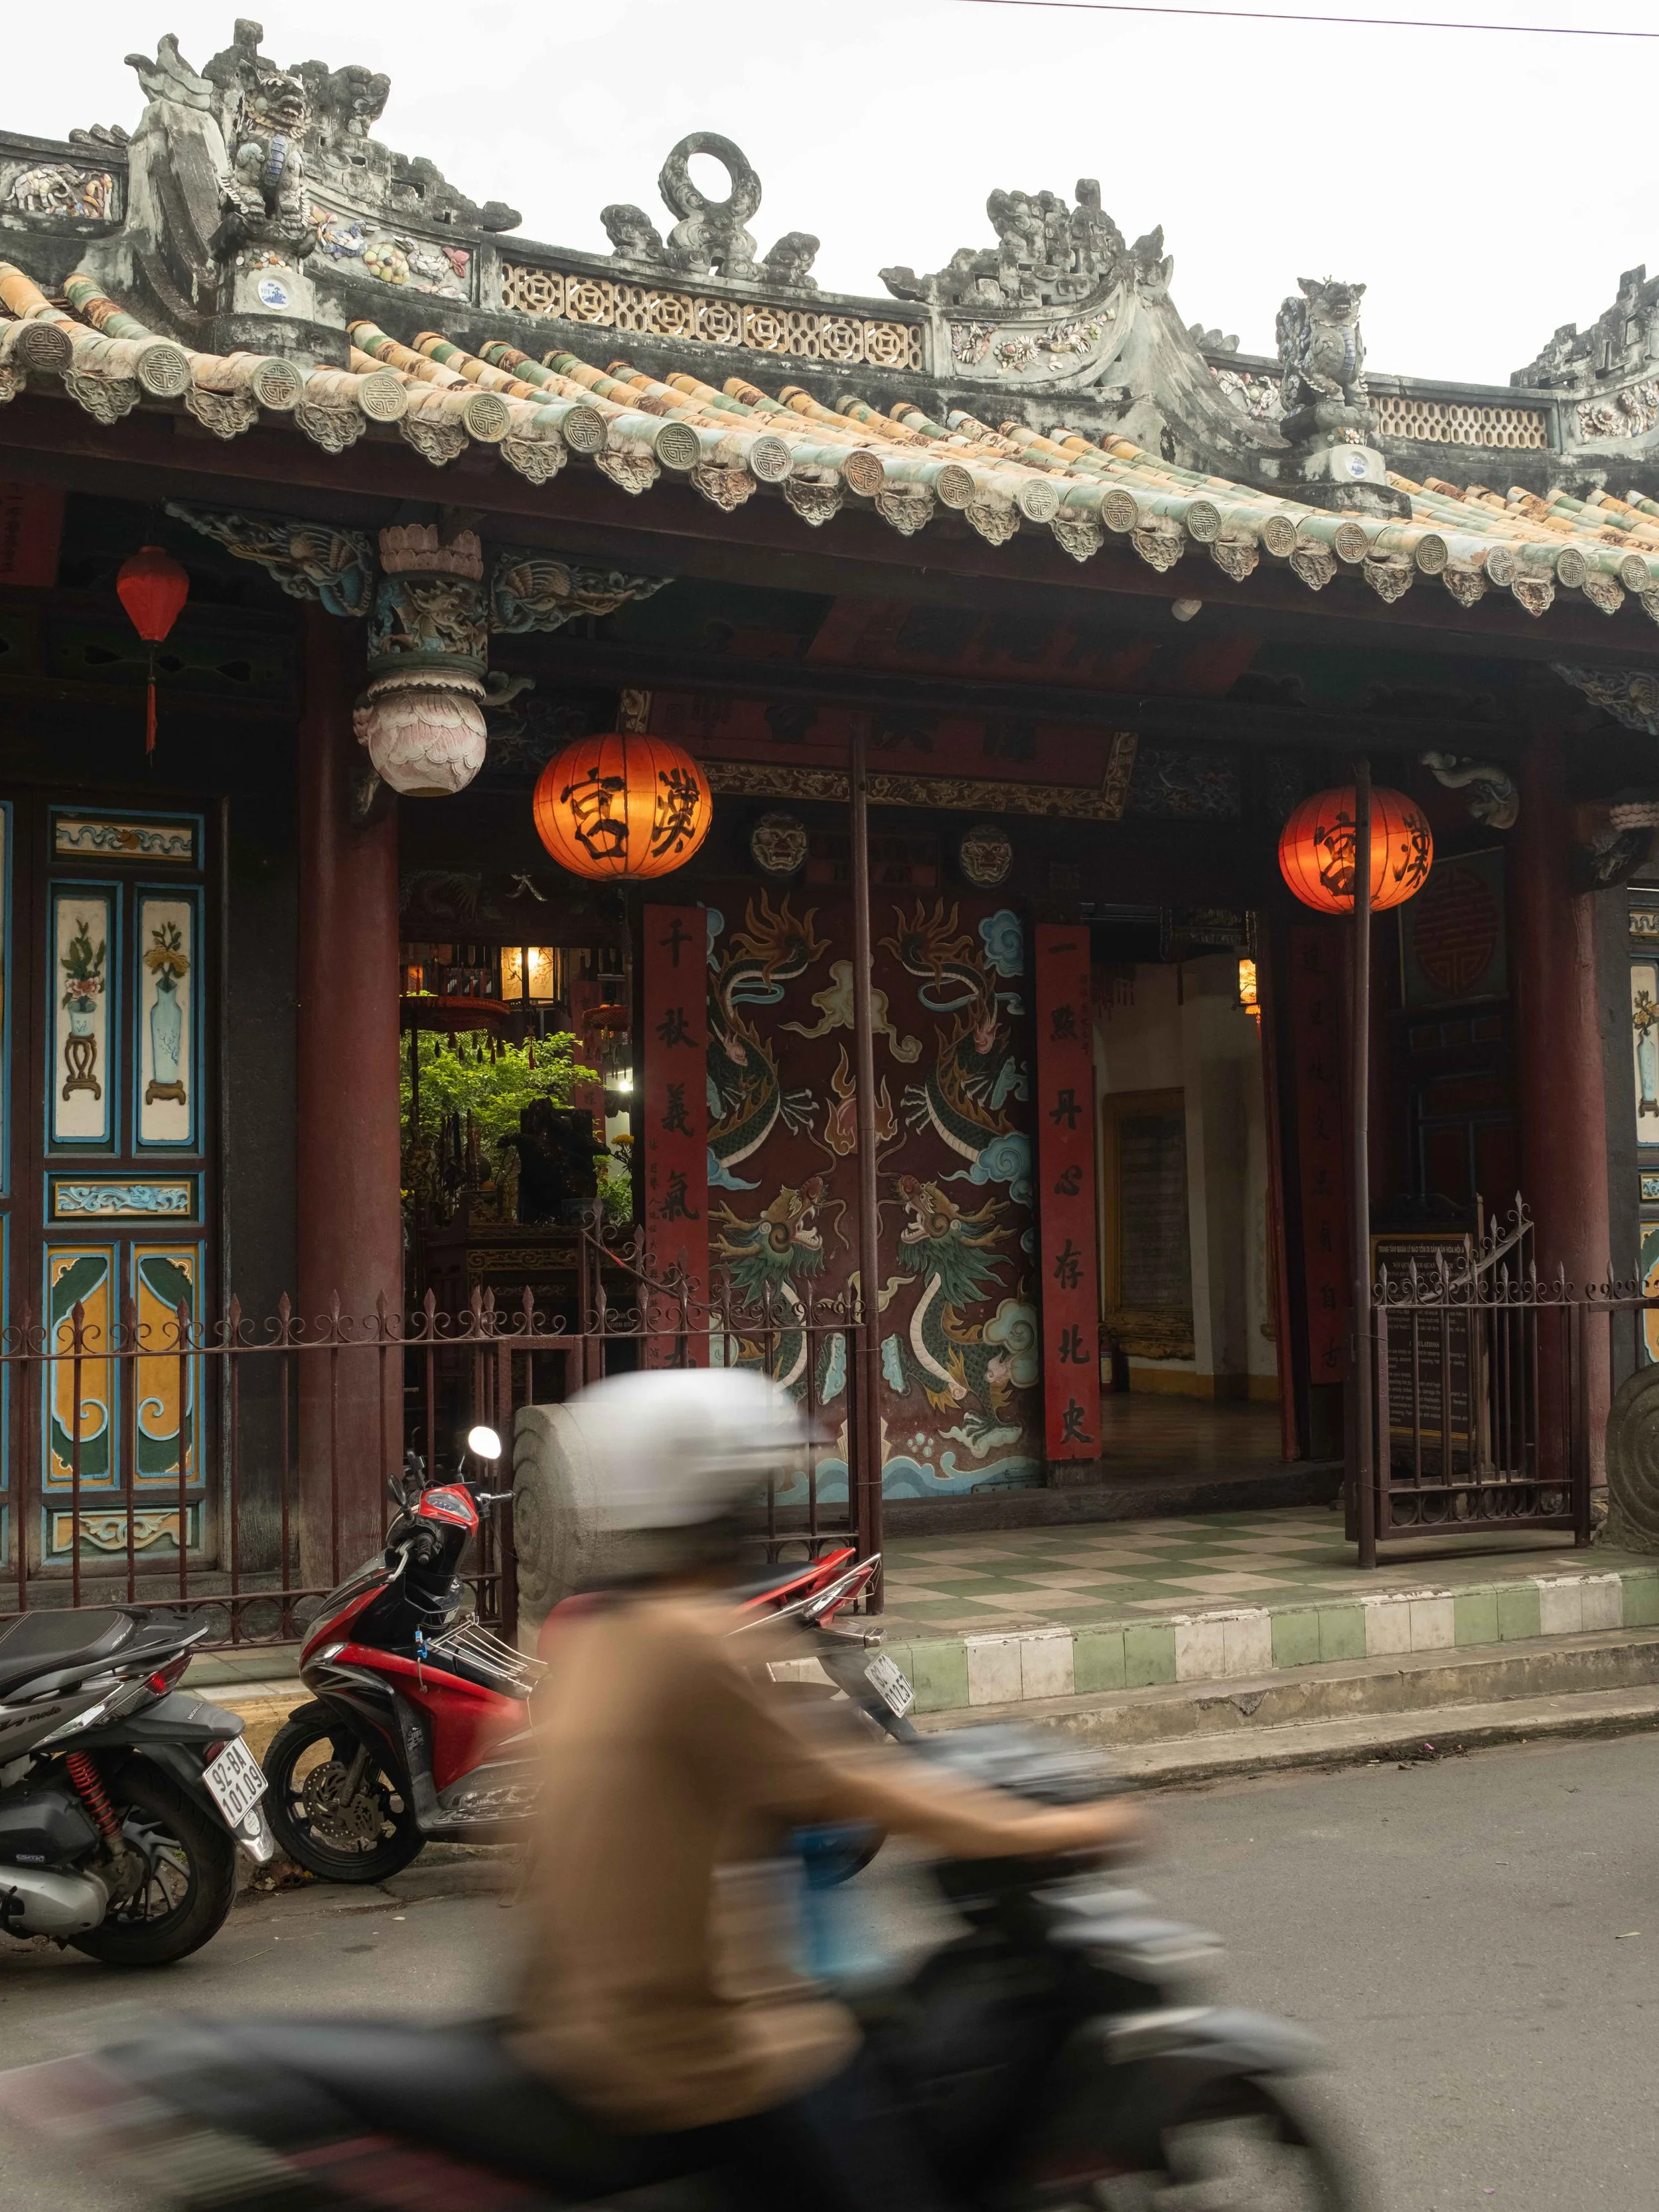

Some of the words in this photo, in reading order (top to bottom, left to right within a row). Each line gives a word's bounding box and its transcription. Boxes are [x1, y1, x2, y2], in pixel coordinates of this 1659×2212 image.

[28, 1706, 62, 1723] mode
[187, 1702, 205, 1720] HONDA
[212, 1745, 247, 1793] 92-BA
[222, 1764, 263, 1818] 101.09
